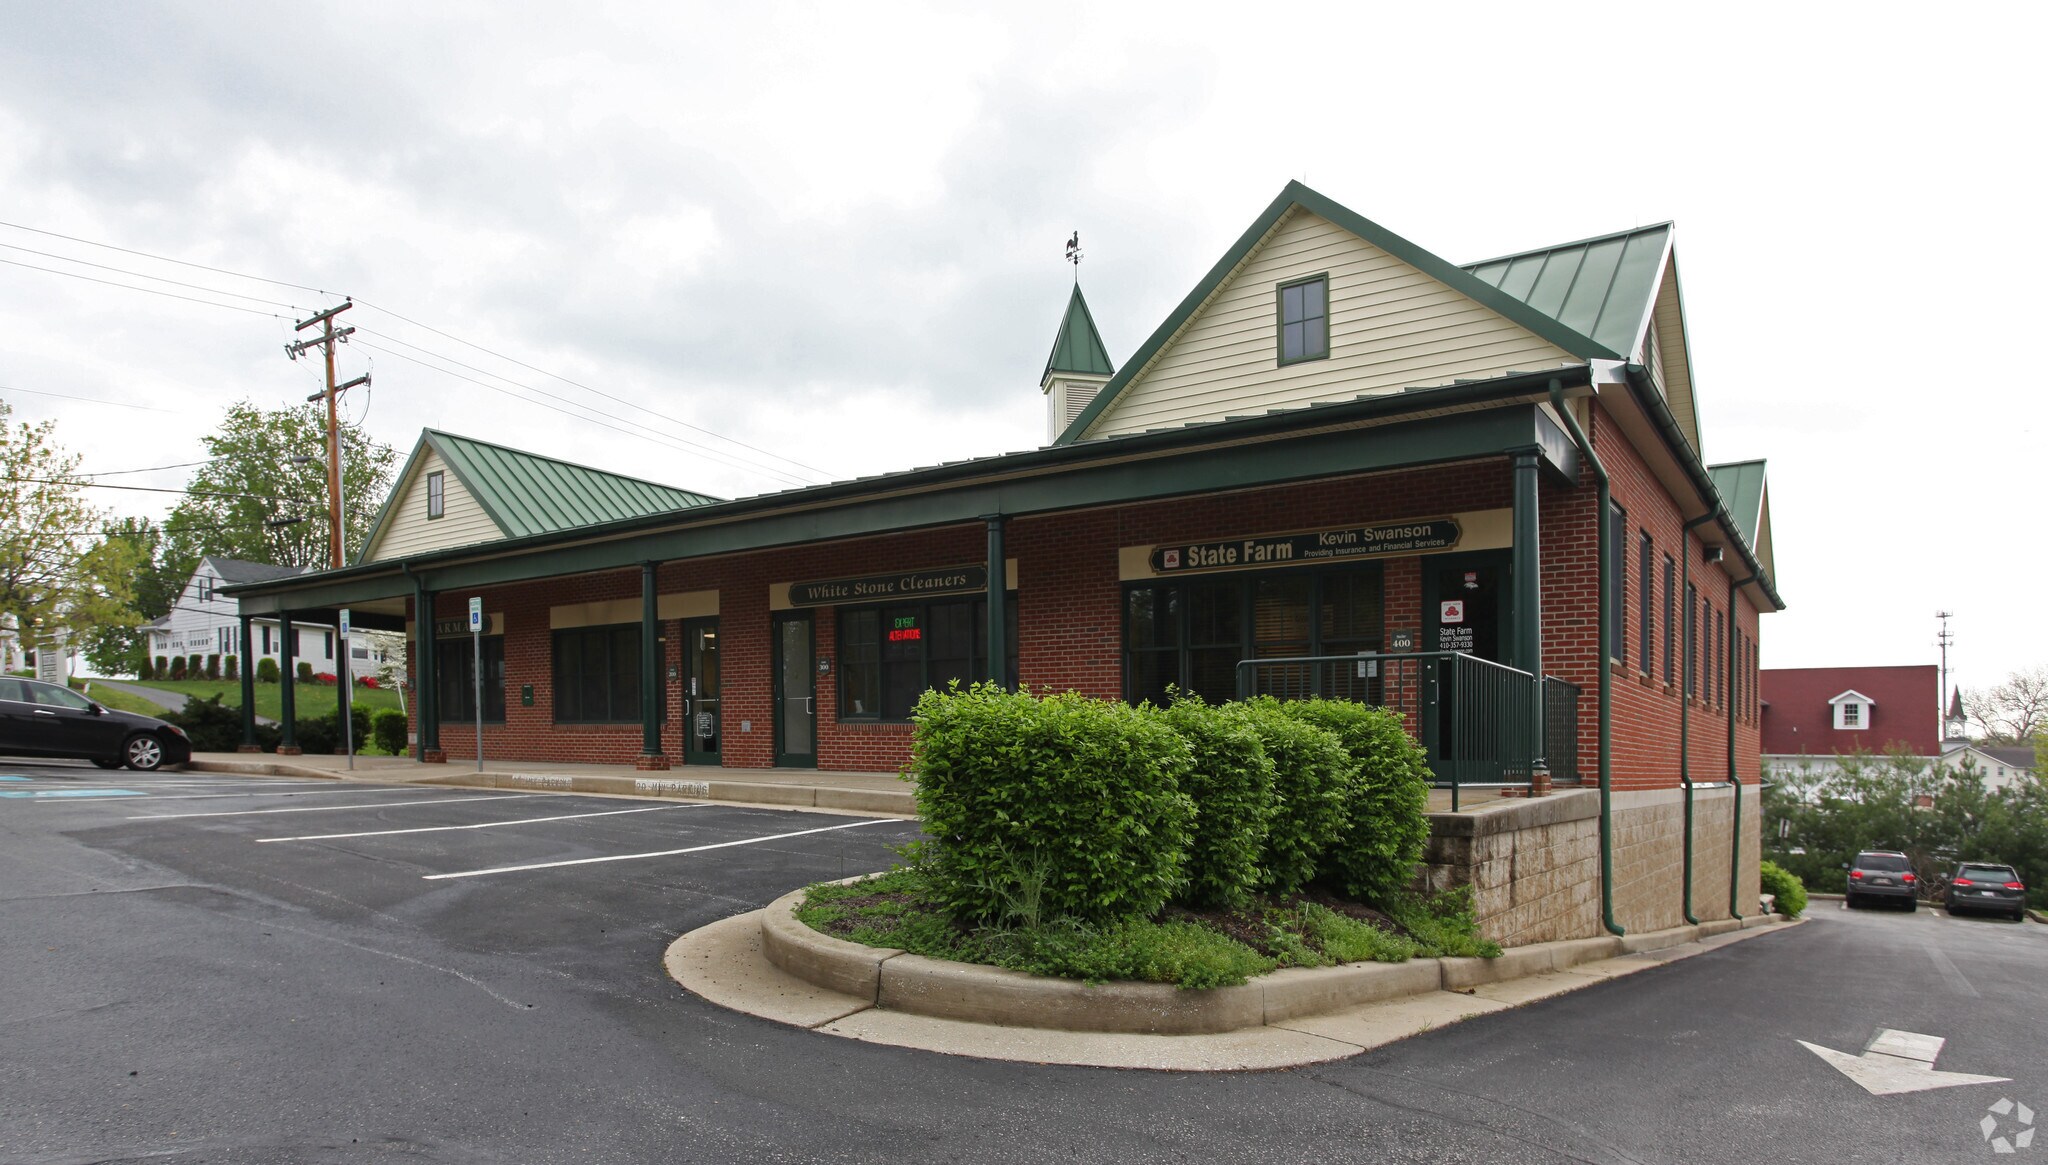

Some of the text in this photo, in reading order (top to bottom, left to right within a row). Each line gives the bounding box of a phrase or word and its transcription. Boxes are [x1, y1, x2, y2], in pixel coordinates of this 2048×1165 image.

[1319, 525, 1431, 546] Kevin Swanson
[1188, 541, 1293, 567] State Farm
[1304, 538, 1445, 558] Providing Insurance and Financial Services
[807, 574, 967, 599] White Stone Cleaners
[1439, 626, 1473, 636] State Farm
[1453, 634, 1473, 642] Swanson
[1392, 639, 1411, 648] 400
[1439, 641, 1474, 649] 410-357-9330
